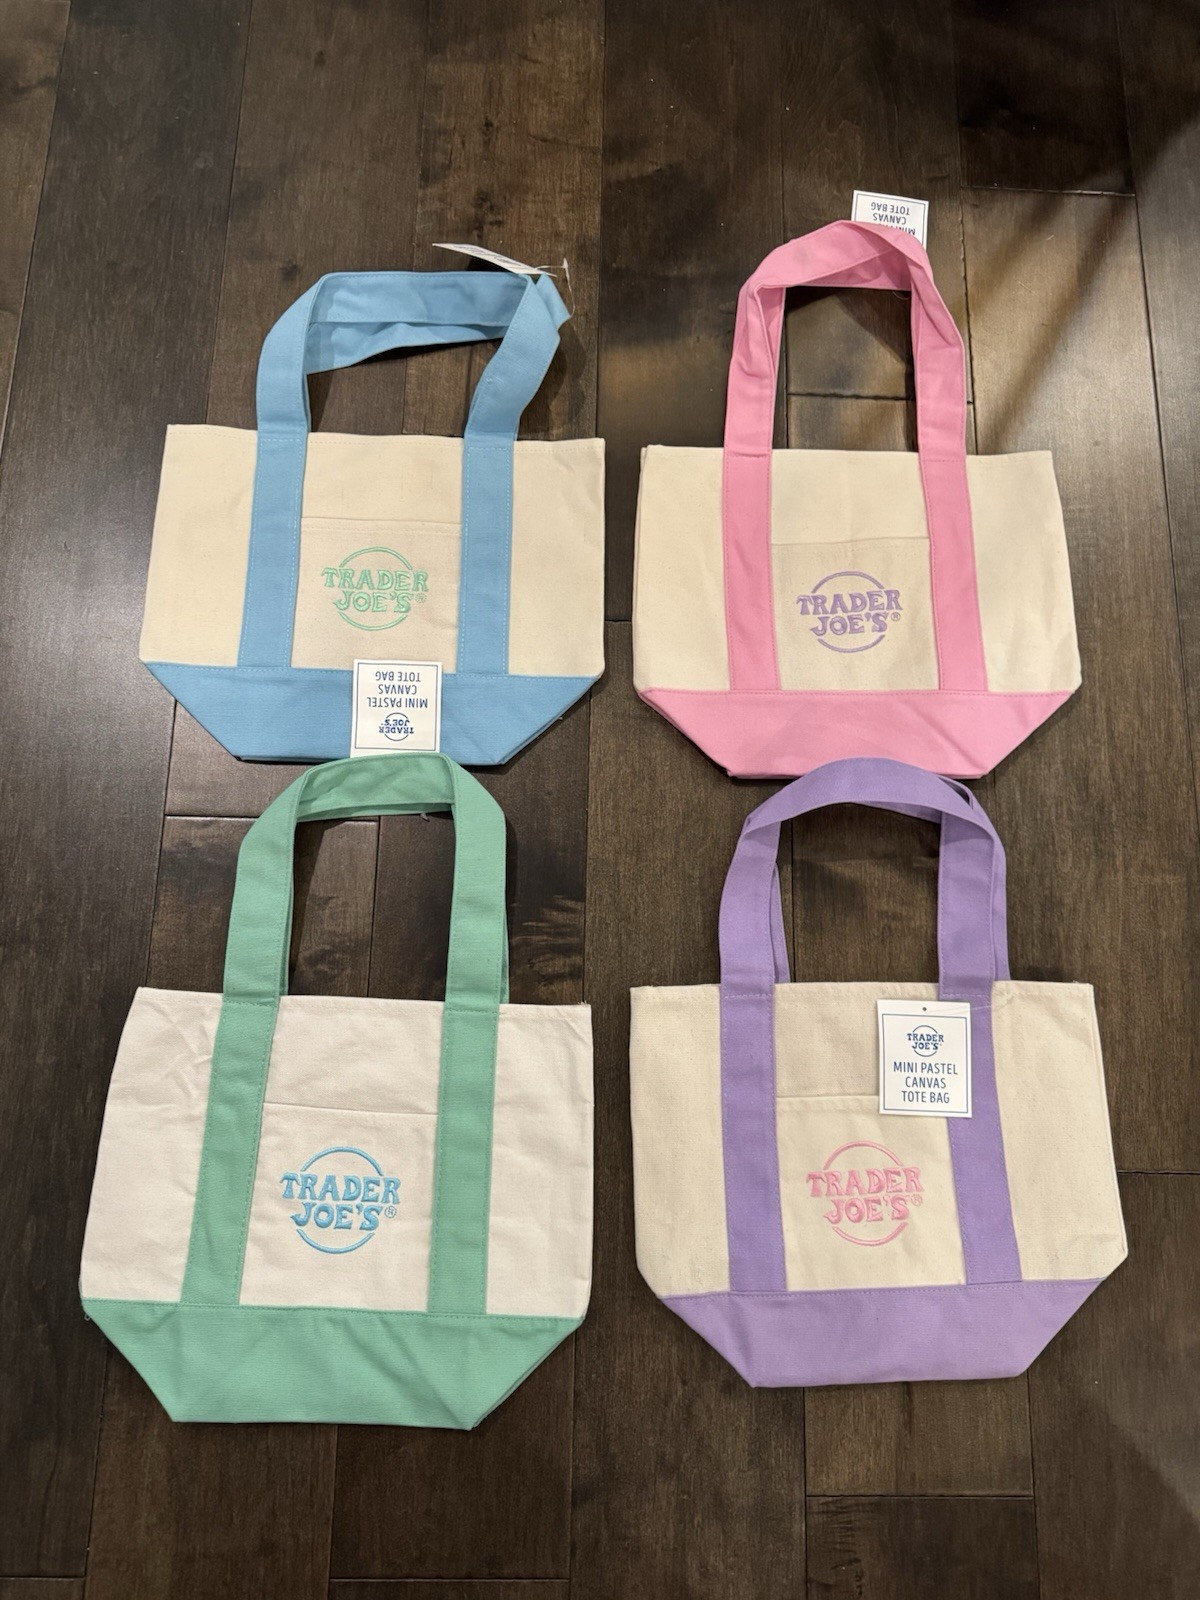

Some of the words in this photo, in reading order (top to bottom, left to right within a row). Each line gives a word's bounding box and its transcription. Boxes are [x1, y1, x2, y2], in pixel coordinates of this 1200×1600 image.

[871, 202, 887, 212] BAG
[890, 205, 910, 215] TOTE
[873, 213, 907, 225] CANVAS
[321, 567, 429, 592] TRADER
[796, 590, 903, 615] TRADER
[375, 671, 394, 681] BAG
[397, 672, 421, 682] TOTE
[378, 684, 417, 695] CANVAS
[367, 697, 402, 708] PASTEL
[405, 698, 428, 708] MINI
[379, 726, 414, 734] TRADER
[907, 1033, 944, 1042] TRADER
[893, 1061, 918, 1073] MINI
[921, 1062, 958, 1075] PASTEL
[905, 1076, 946, 1089] CANVAS
[902, 1091, 926, 1103] TOTE
[930, 1092, 950, 1104] BAG
[806, 1167, 924, 1197] TRADER
[280, 1172, 401, 1204] TRADER
